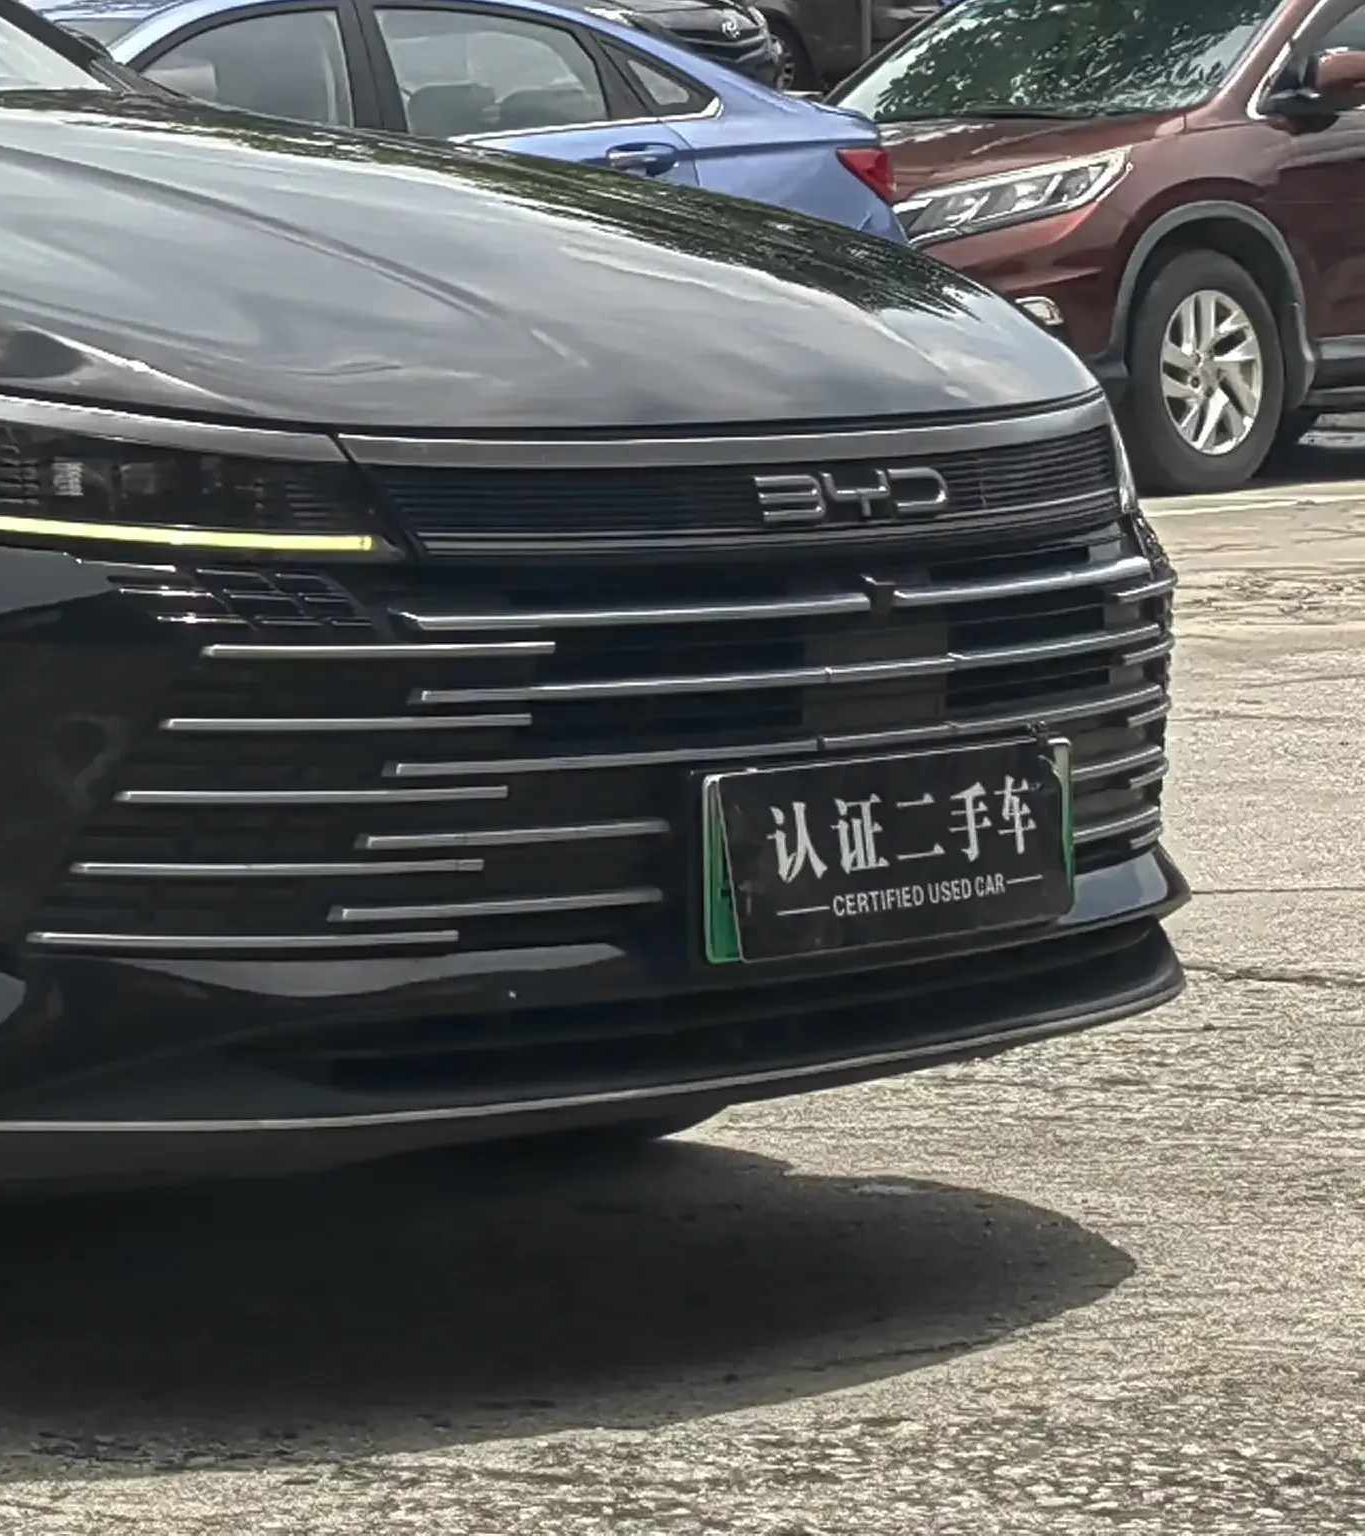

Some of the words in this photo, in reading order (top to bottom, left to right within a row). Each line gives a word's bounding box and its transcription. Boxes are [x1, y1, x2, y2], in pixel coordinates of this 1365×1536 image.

[753, 467, 948, 523] BYD
[767, 775, 1037, 883] 认证二手车
[832, 886, 924, 917] CERTIFIED
[928, 880, 971, 905] USED
[974, 873, 1006, 897] CAR
